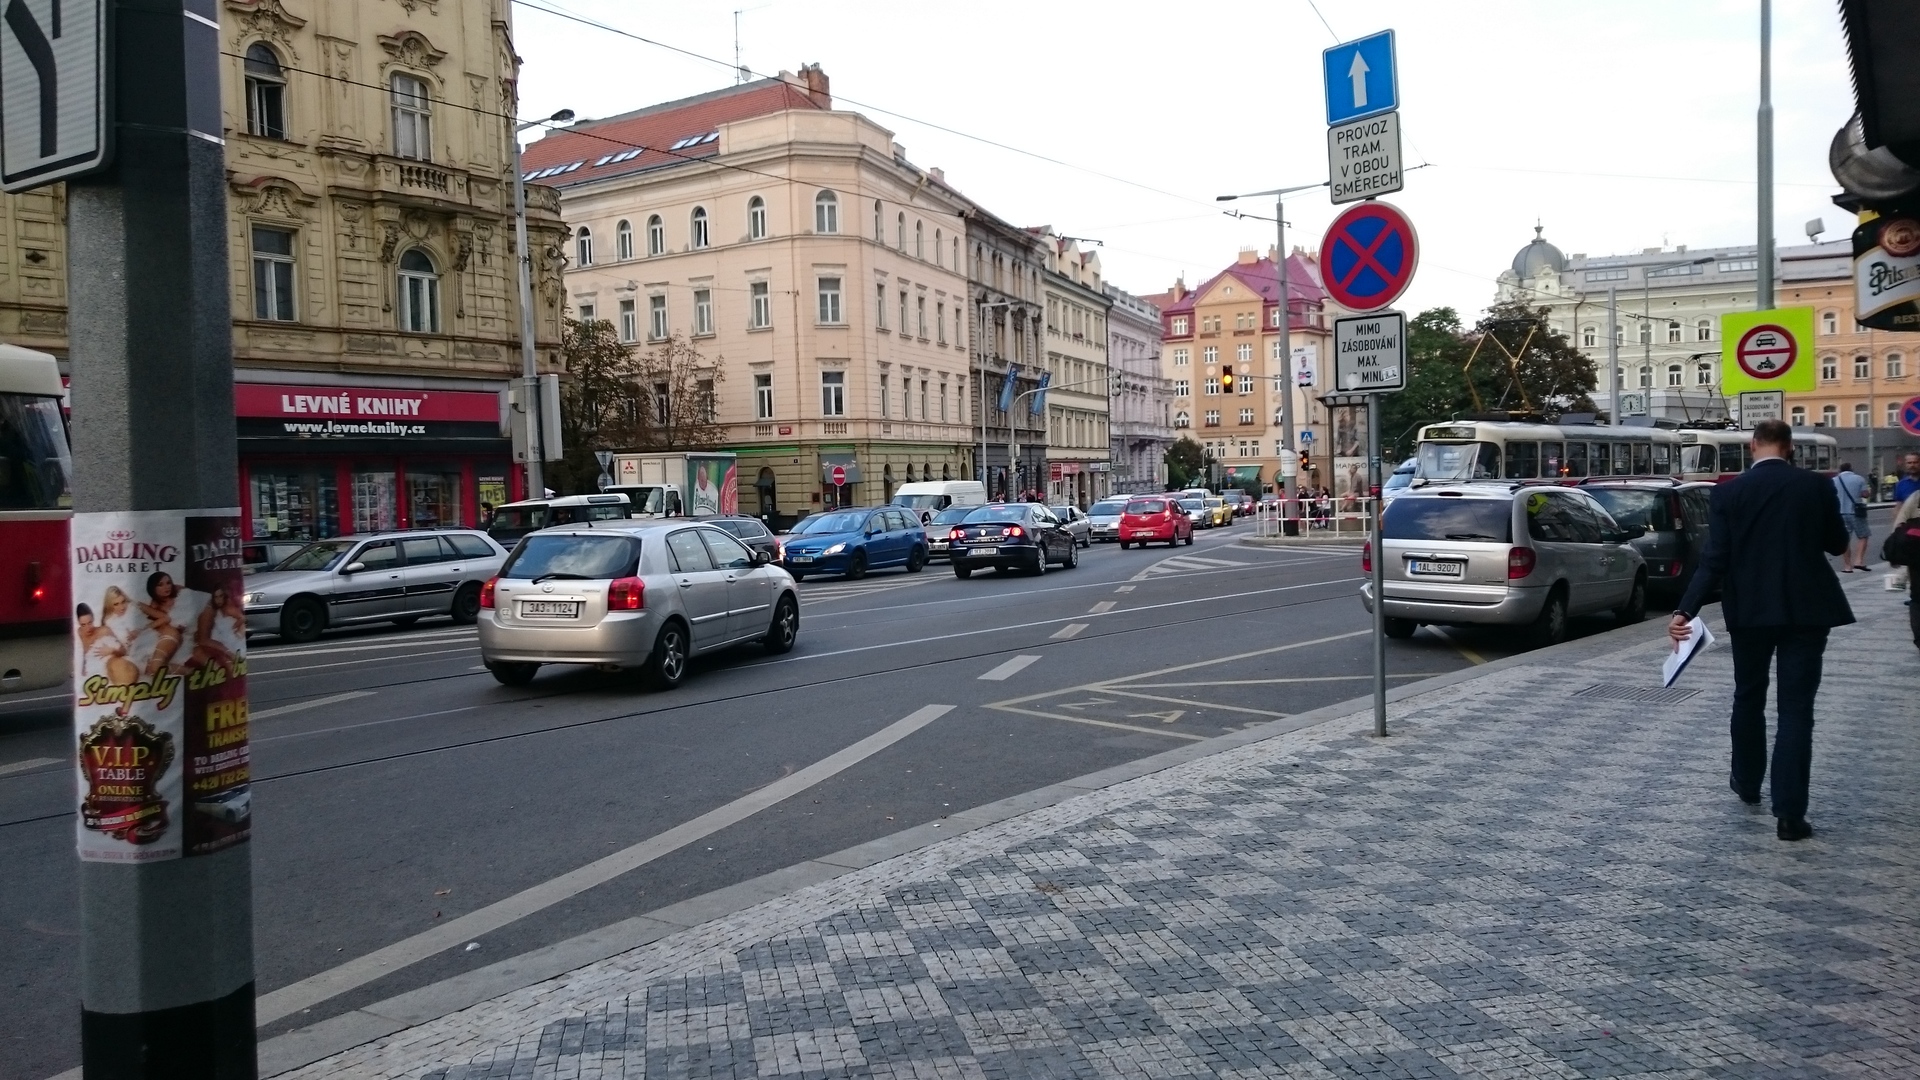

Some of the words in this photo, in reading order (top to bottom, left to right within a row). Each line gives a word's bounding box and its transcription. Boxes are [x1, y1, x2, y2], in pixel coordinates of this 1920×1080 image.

[1337, 120, 1388, 144] PROVOZ
[1343, 139, 1385, 160] TRAM.
[1340, 164, 1349, 178] V
[1353, 155, 1389, 175] OBOU
[1334, 170, 1399, 197] SMĚRECH
[1356, 322, 1380, 336] MIMO
[1341, 334, 1397, 353] ZÁSOBOVÁNÍ
[1357, 355, 1380, 368] MAX.
[1362, 370, 1386, 383] MINU
[282, 392, 350, 414] LEVNÉ
[357, 397, 422, 416] KNIHY
[284, 421, 426, 437] www.levneknihy.cz
[76, 543, 178, 564] DARLING
[86, 562, 163, 573] CABARET
[1417, 563, 1431, 572] 1AL
[1437, 564, 1456, 573] 9207
[529, 603, 545, 613] 3A3
[552, 603, 573, 613] 1124
[79, 666, 181, 716] Simply
[188, 657, 226, 691] the
[91, 745, 154, 767] V.I.P.
[194, 756, 208, 766] TO
[97, 768, 146, 780] TABLE
[98, 785, 144, 796] ONLINE
